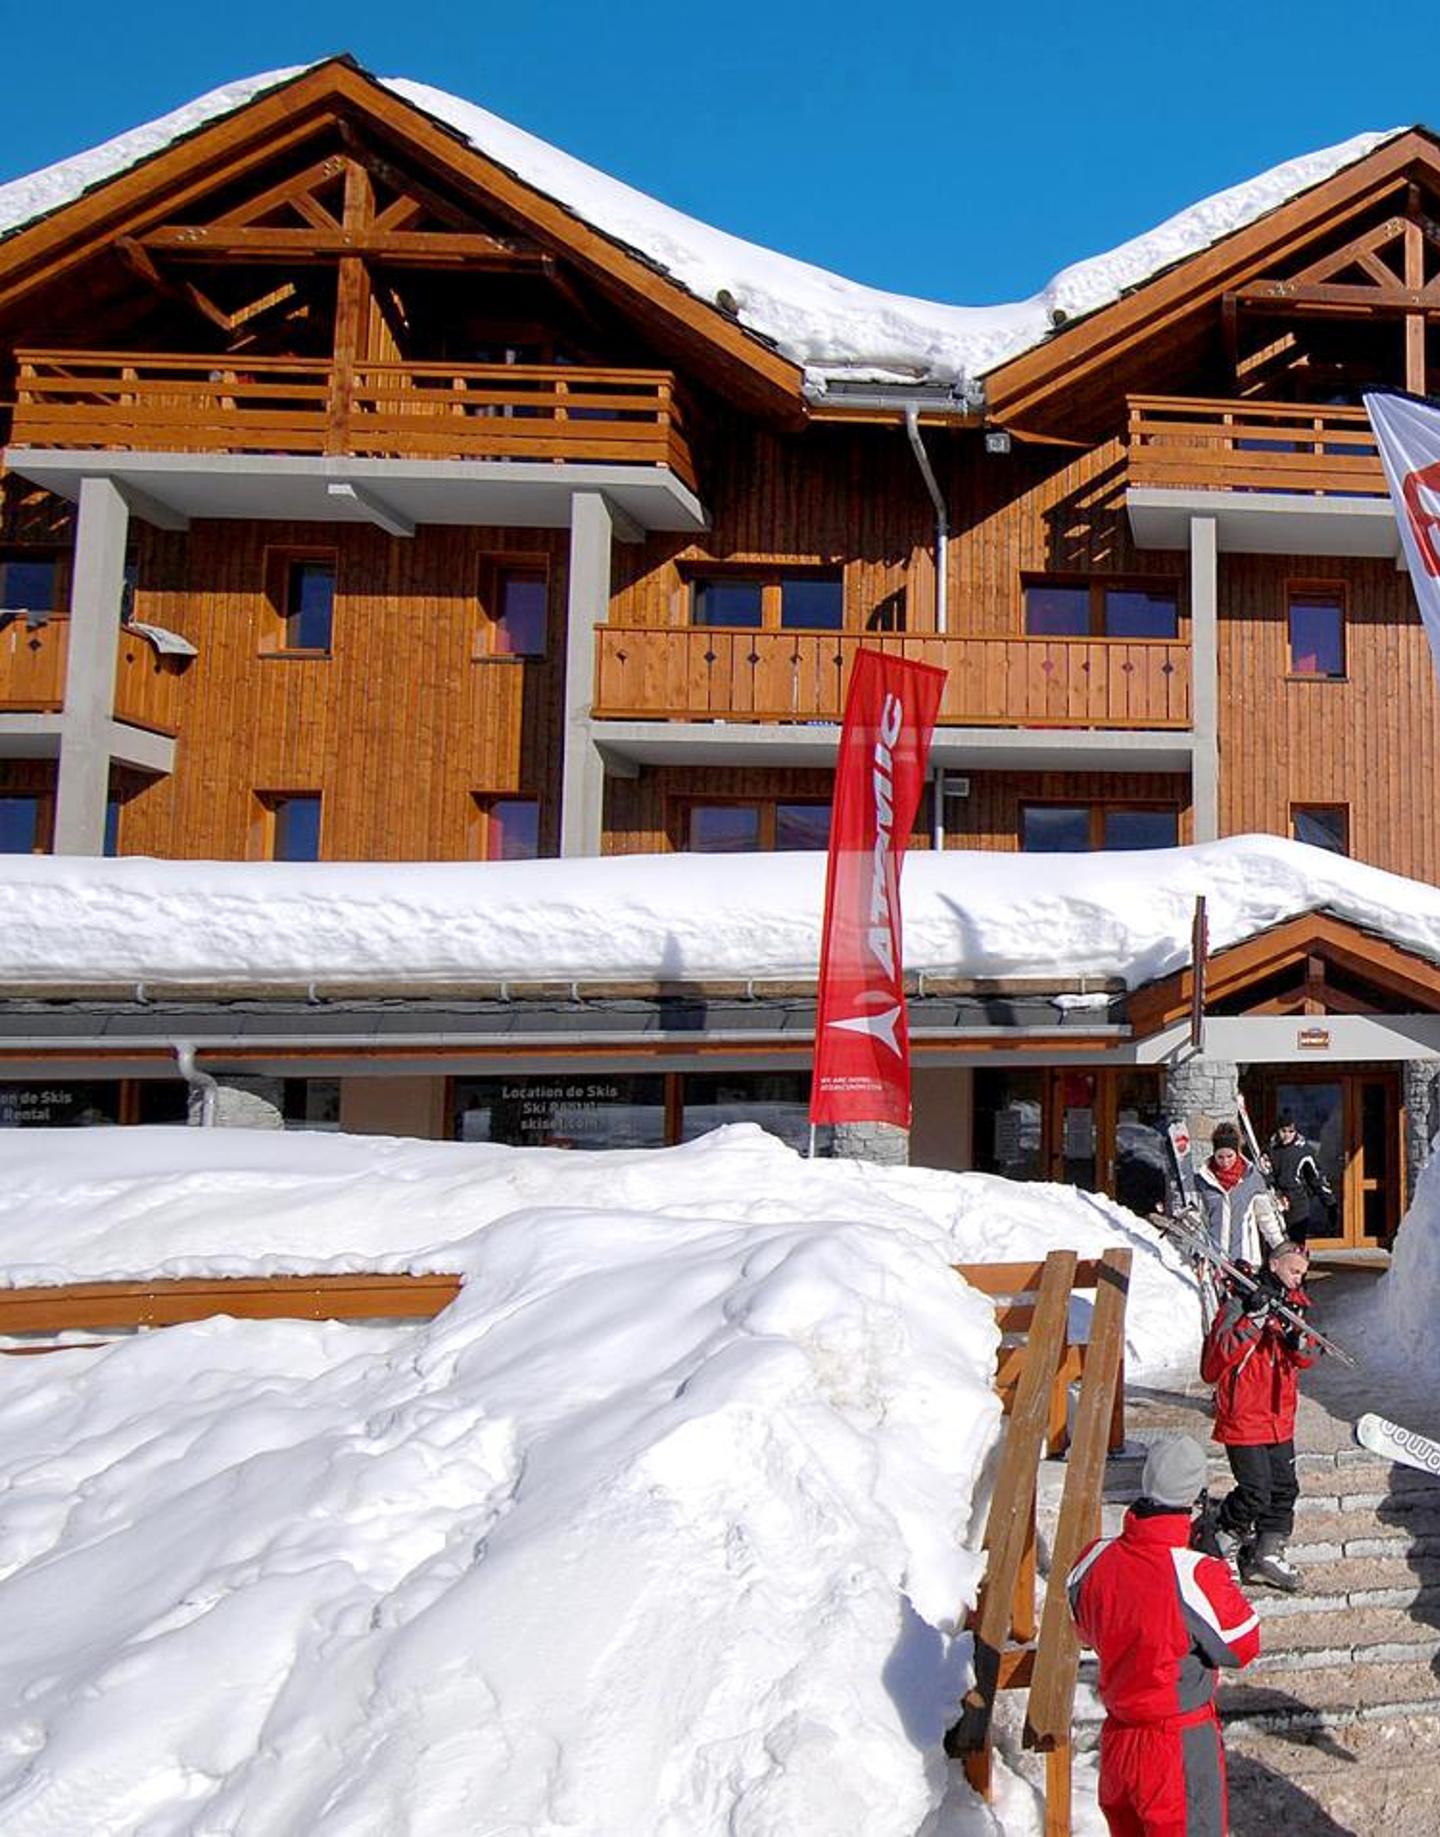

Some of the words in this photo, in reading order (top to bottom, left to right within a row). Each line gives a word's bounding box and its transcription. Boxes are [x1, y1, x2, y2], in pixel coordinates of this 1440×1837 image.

[20, 1091, 38, 1104] de
[41, 1090, 72, 1104] Skis
[502, 1085, 563, 1099] Location
[566, 1085, 584, 1097] de
[587, 1084, 618, 1098] Skis
[3, 1107, 50, 1120] Rental
[523, 1101, 546, 1114] Ski
